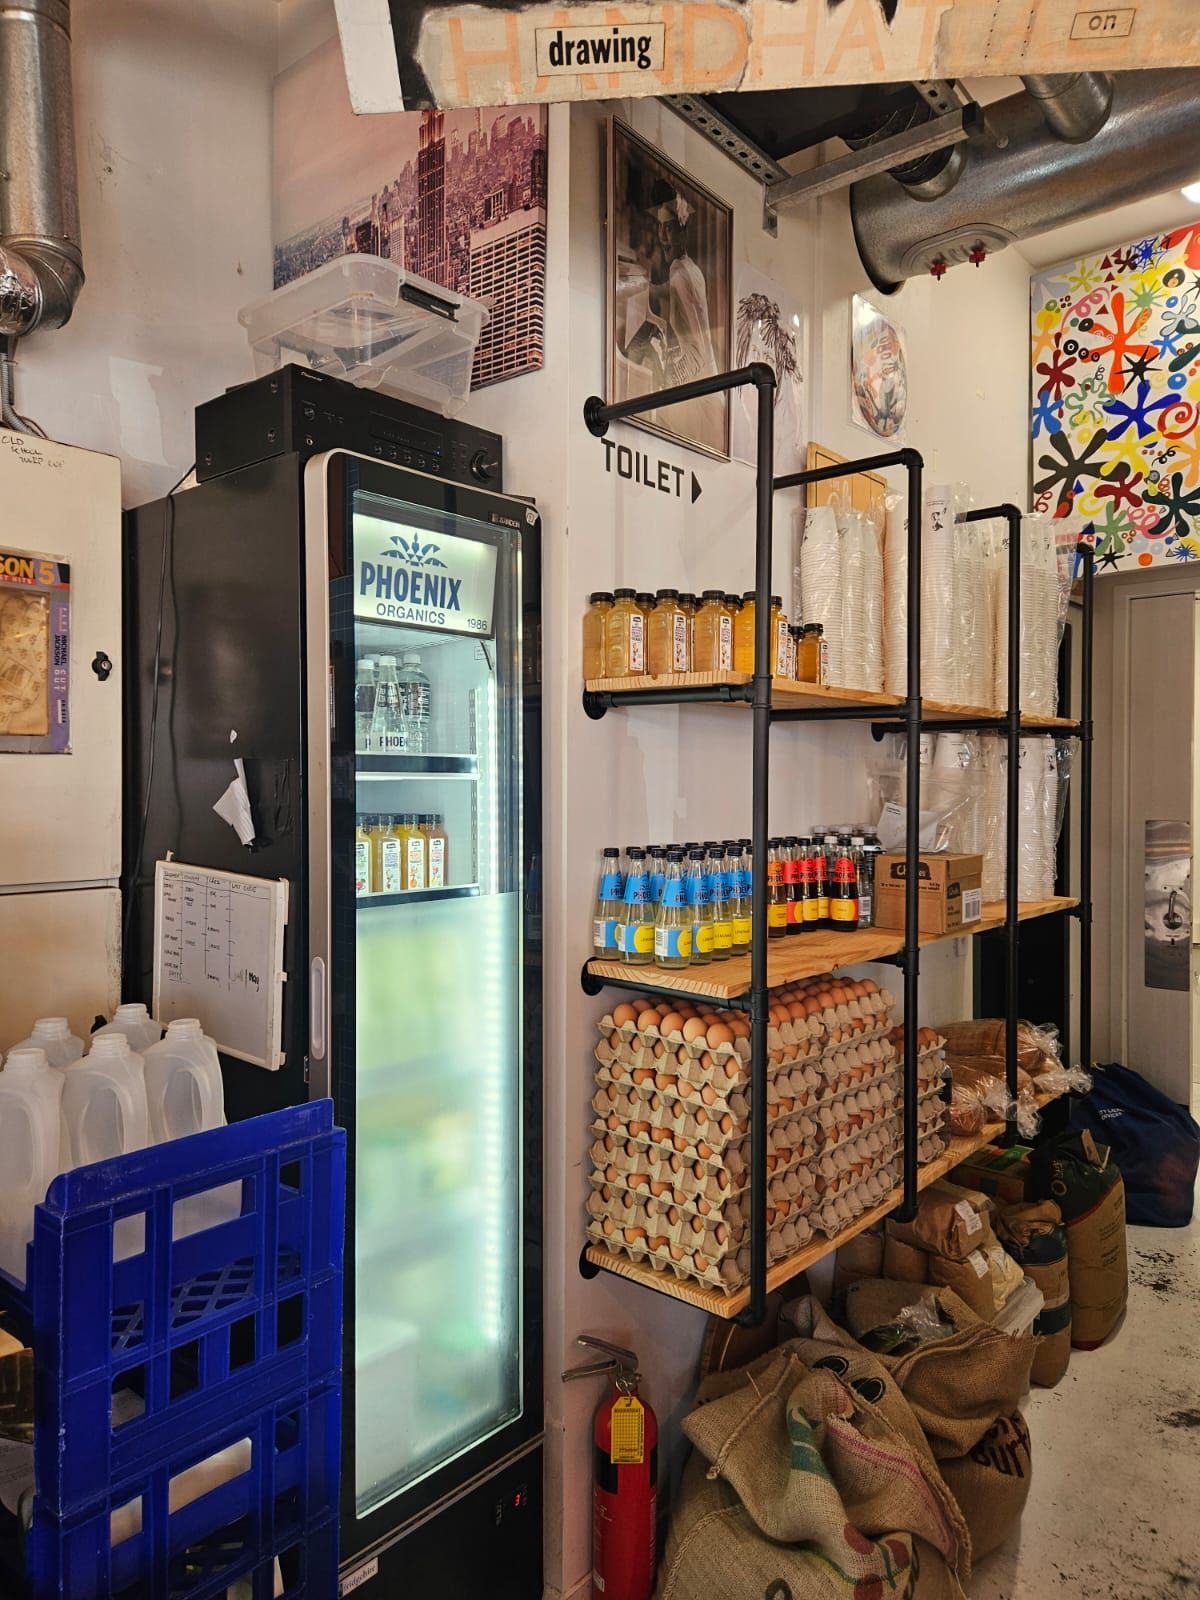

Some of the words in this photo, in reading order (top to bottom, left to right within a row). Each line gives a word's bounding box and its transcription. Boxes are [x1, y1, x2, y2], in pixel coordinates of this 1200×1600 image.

[1088, 15, 1117, 31] on
[549, 28, 652, 69] drawing
[600, 437, 685, 498] TOILET
[39, 560, 55, 585] 5
[360, 561, 462, 611] PHOENIX
[376, 602, 446, 625] ORGANICS
[467, 618, 488, 631] 1986
